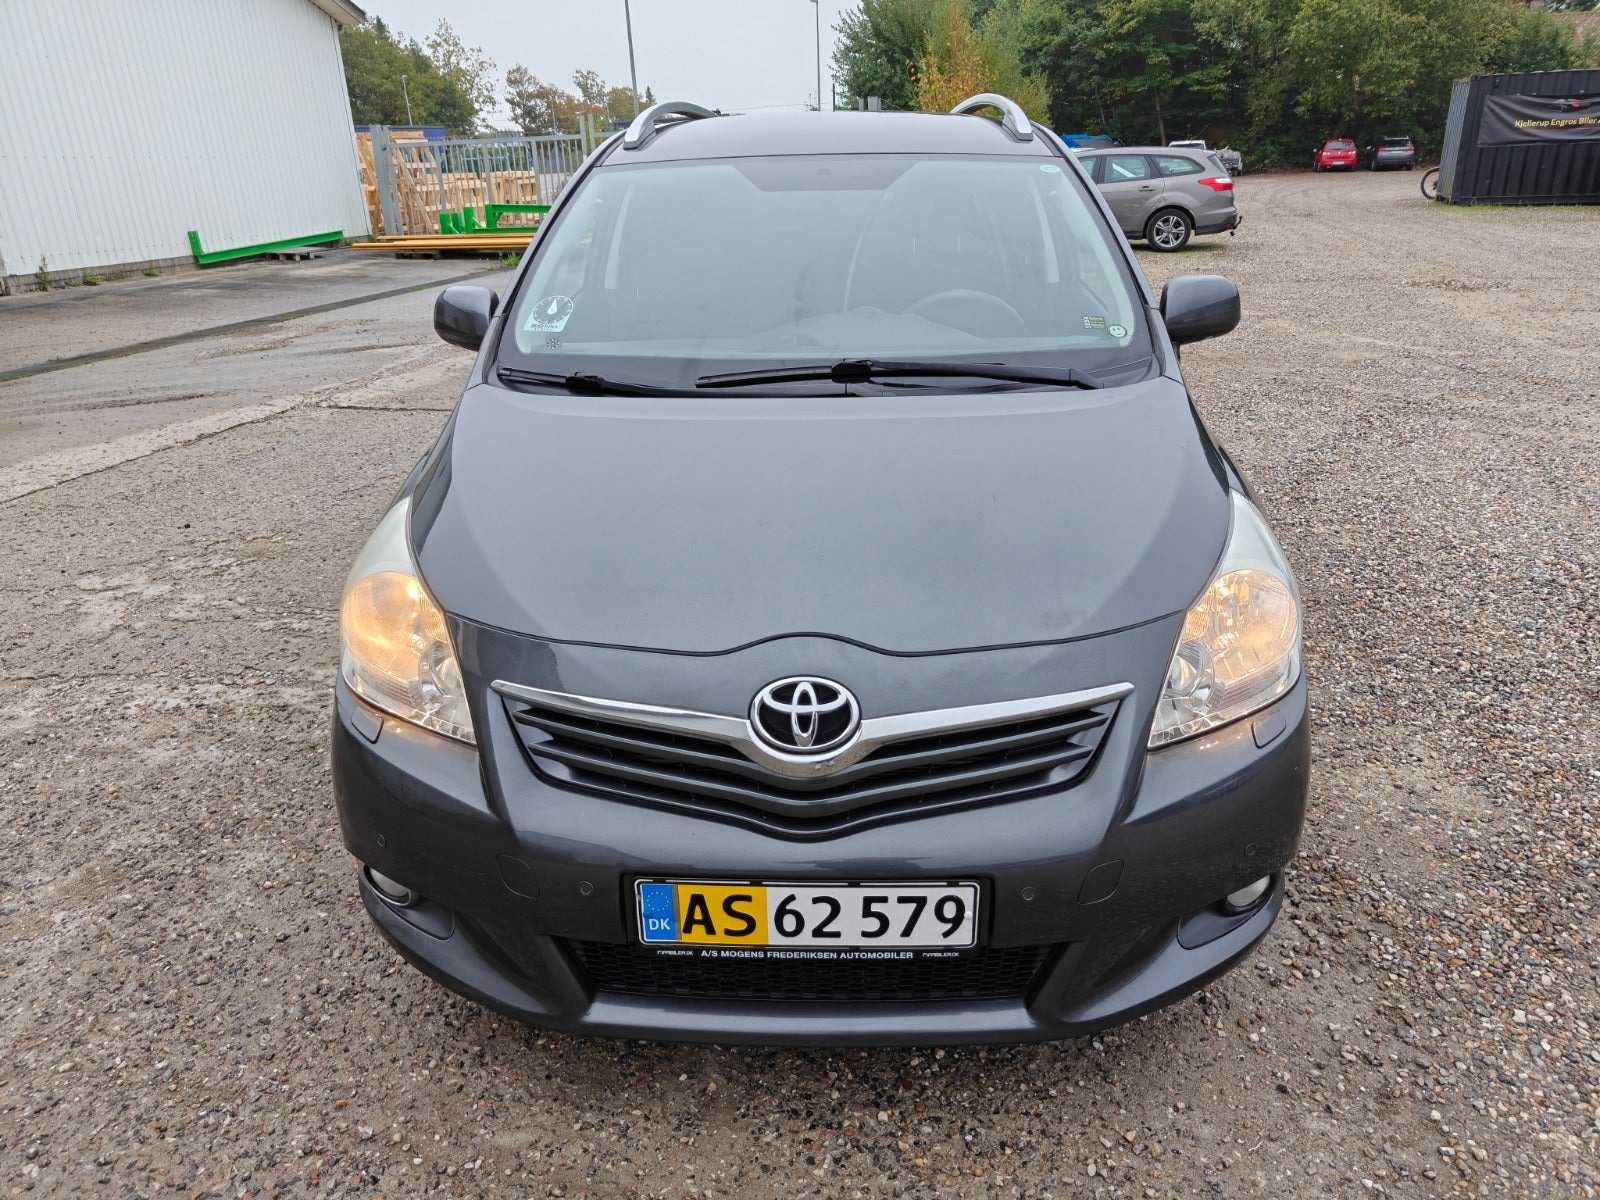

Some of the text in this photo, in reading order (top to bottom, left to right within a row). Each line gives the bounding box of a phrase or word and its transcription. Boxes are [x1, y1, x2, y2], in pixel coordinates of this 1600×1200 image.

[1515, 120, 1549, 128] Kjellerup
[1551, 119, 1577, 127] Engros
[682, 893, 966, 939] AS 62 579
[648, 918, 671, 931] DK
[701, 950, 718, 958] A/S
[720, 950, 764, 958] MOGENS
[767, 951, 837, 959] FREDERIKSEN
[839, 951, 913, 960] AUTOMOBILER
